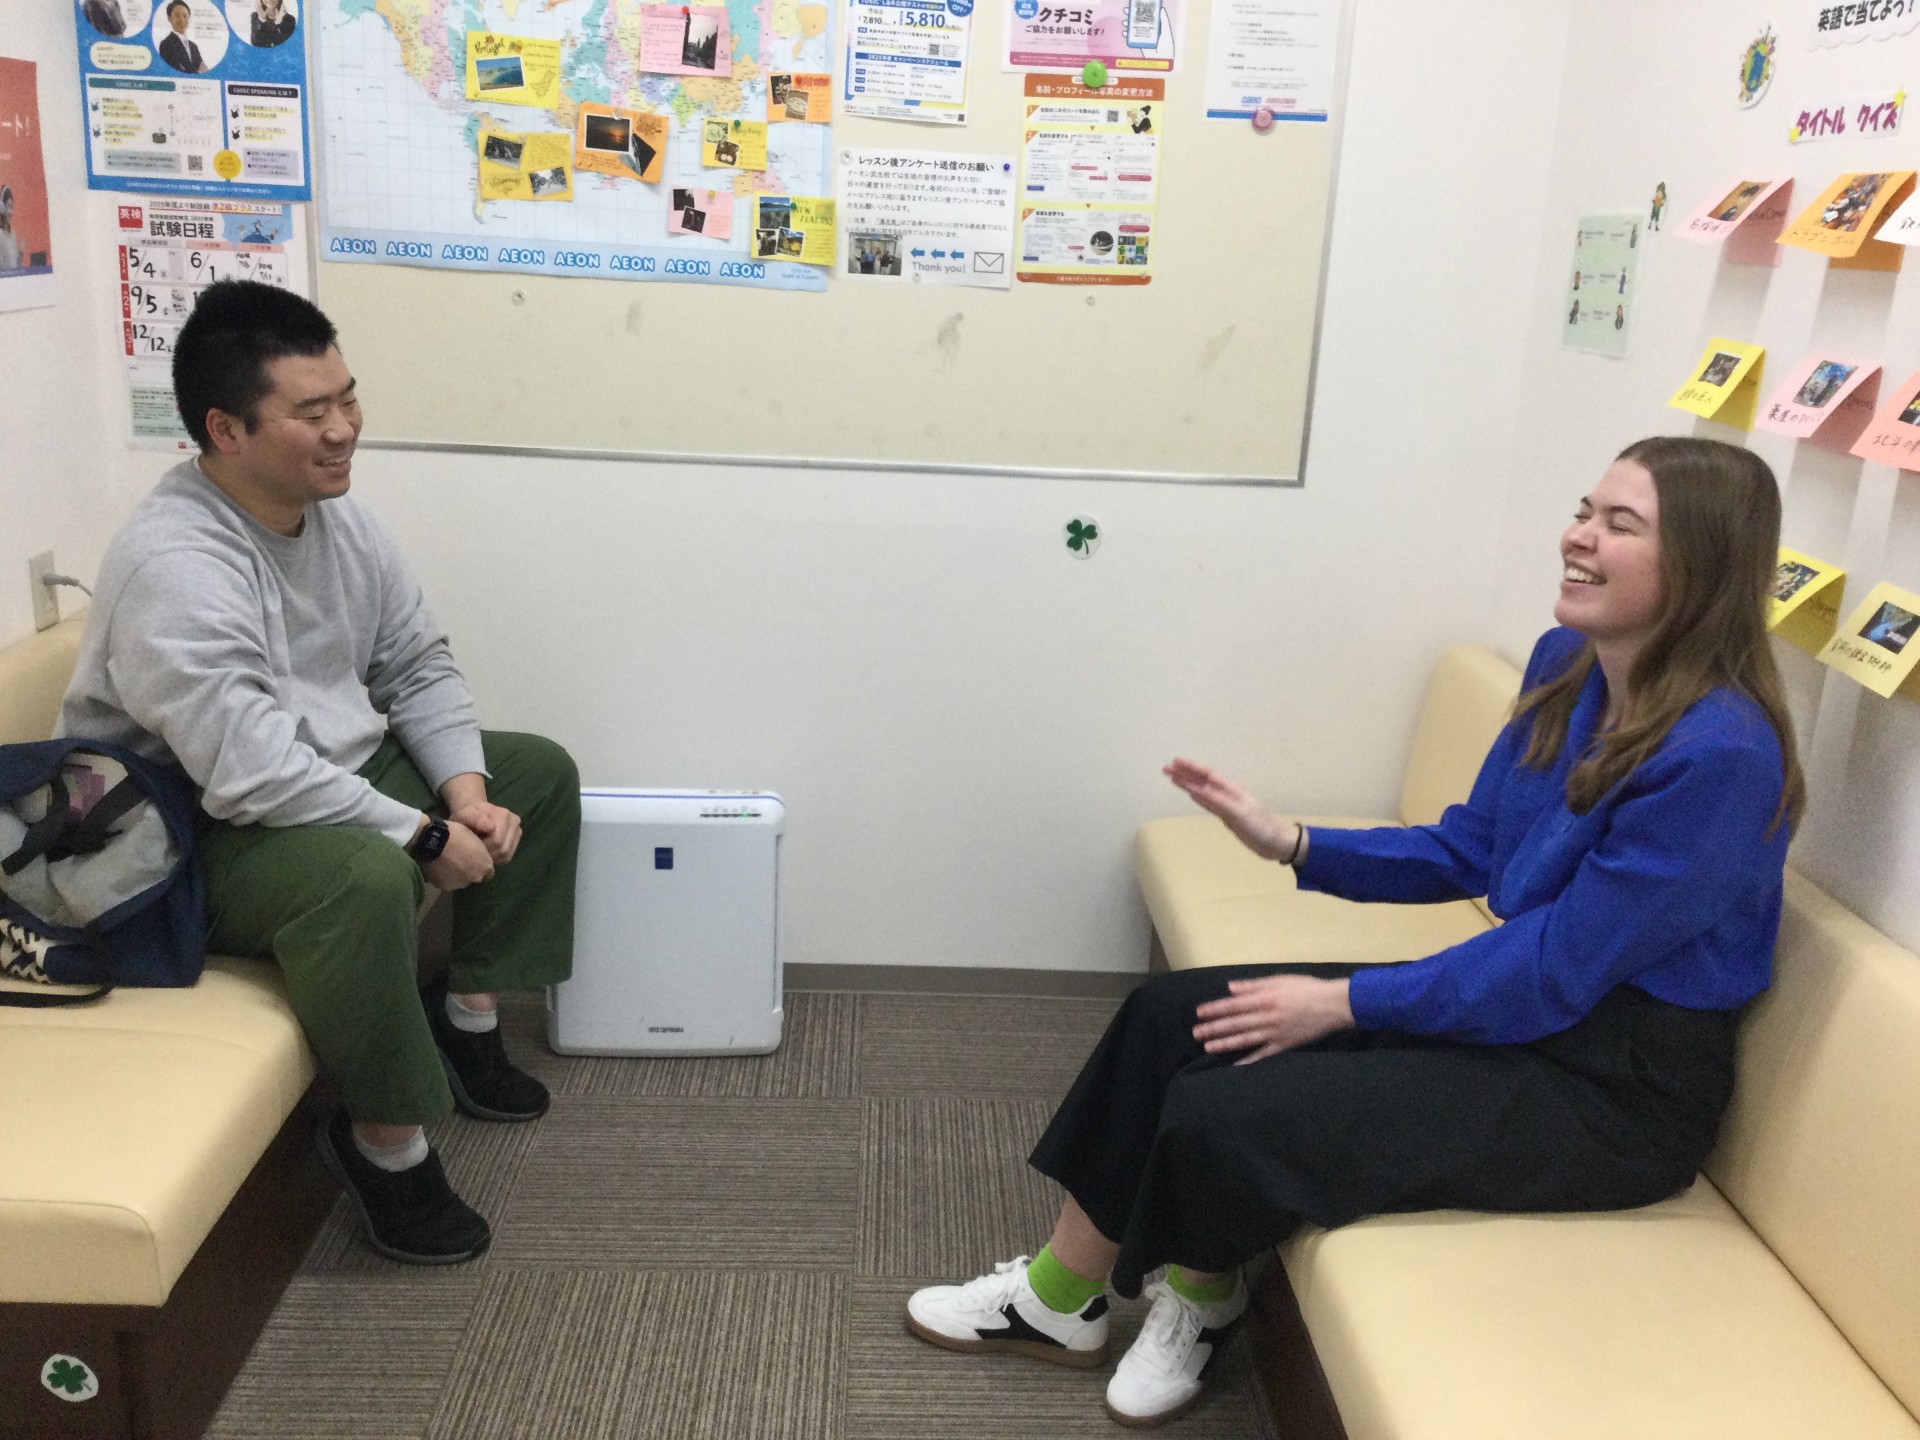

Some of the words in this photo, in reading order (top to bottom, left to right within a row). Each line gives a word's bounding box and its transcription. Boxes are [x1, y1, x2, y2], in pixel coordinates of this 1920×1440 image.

[905, 11, 946, 28] 5,810
[1038, 7, 1093, 25] クチコミ
[1817, 0, 1914, 32] 英語で当てよう!
[1024, 25, 1105, 36] ご協力をお願いします!
[474, 37, 505, 54] Portugal
[1796, 106, 1845, 136] タイトル
[1857, 101, 1899, 132] クイズ
[859, 156, 994, 172] レッスン後アンケート送信のお願い
[120, 208, 142, 220] 英検
[150, 221, 215, 238] 試験日程
[331, 238, 376, 254] AEON
[386, 242, 432, 258] AEON
[442, 245, 488, 261] AEON
[498, 248, 544, 265] AEON
[554, 252, 600, 268] AEON
[610, 256, 655, 272] AEON
[665, 259, 710, 275] AEON
[720, 262, 765, 279] AEON
[912, 261, 942, 272] Thank
[945, 262, 965, 274] you!
